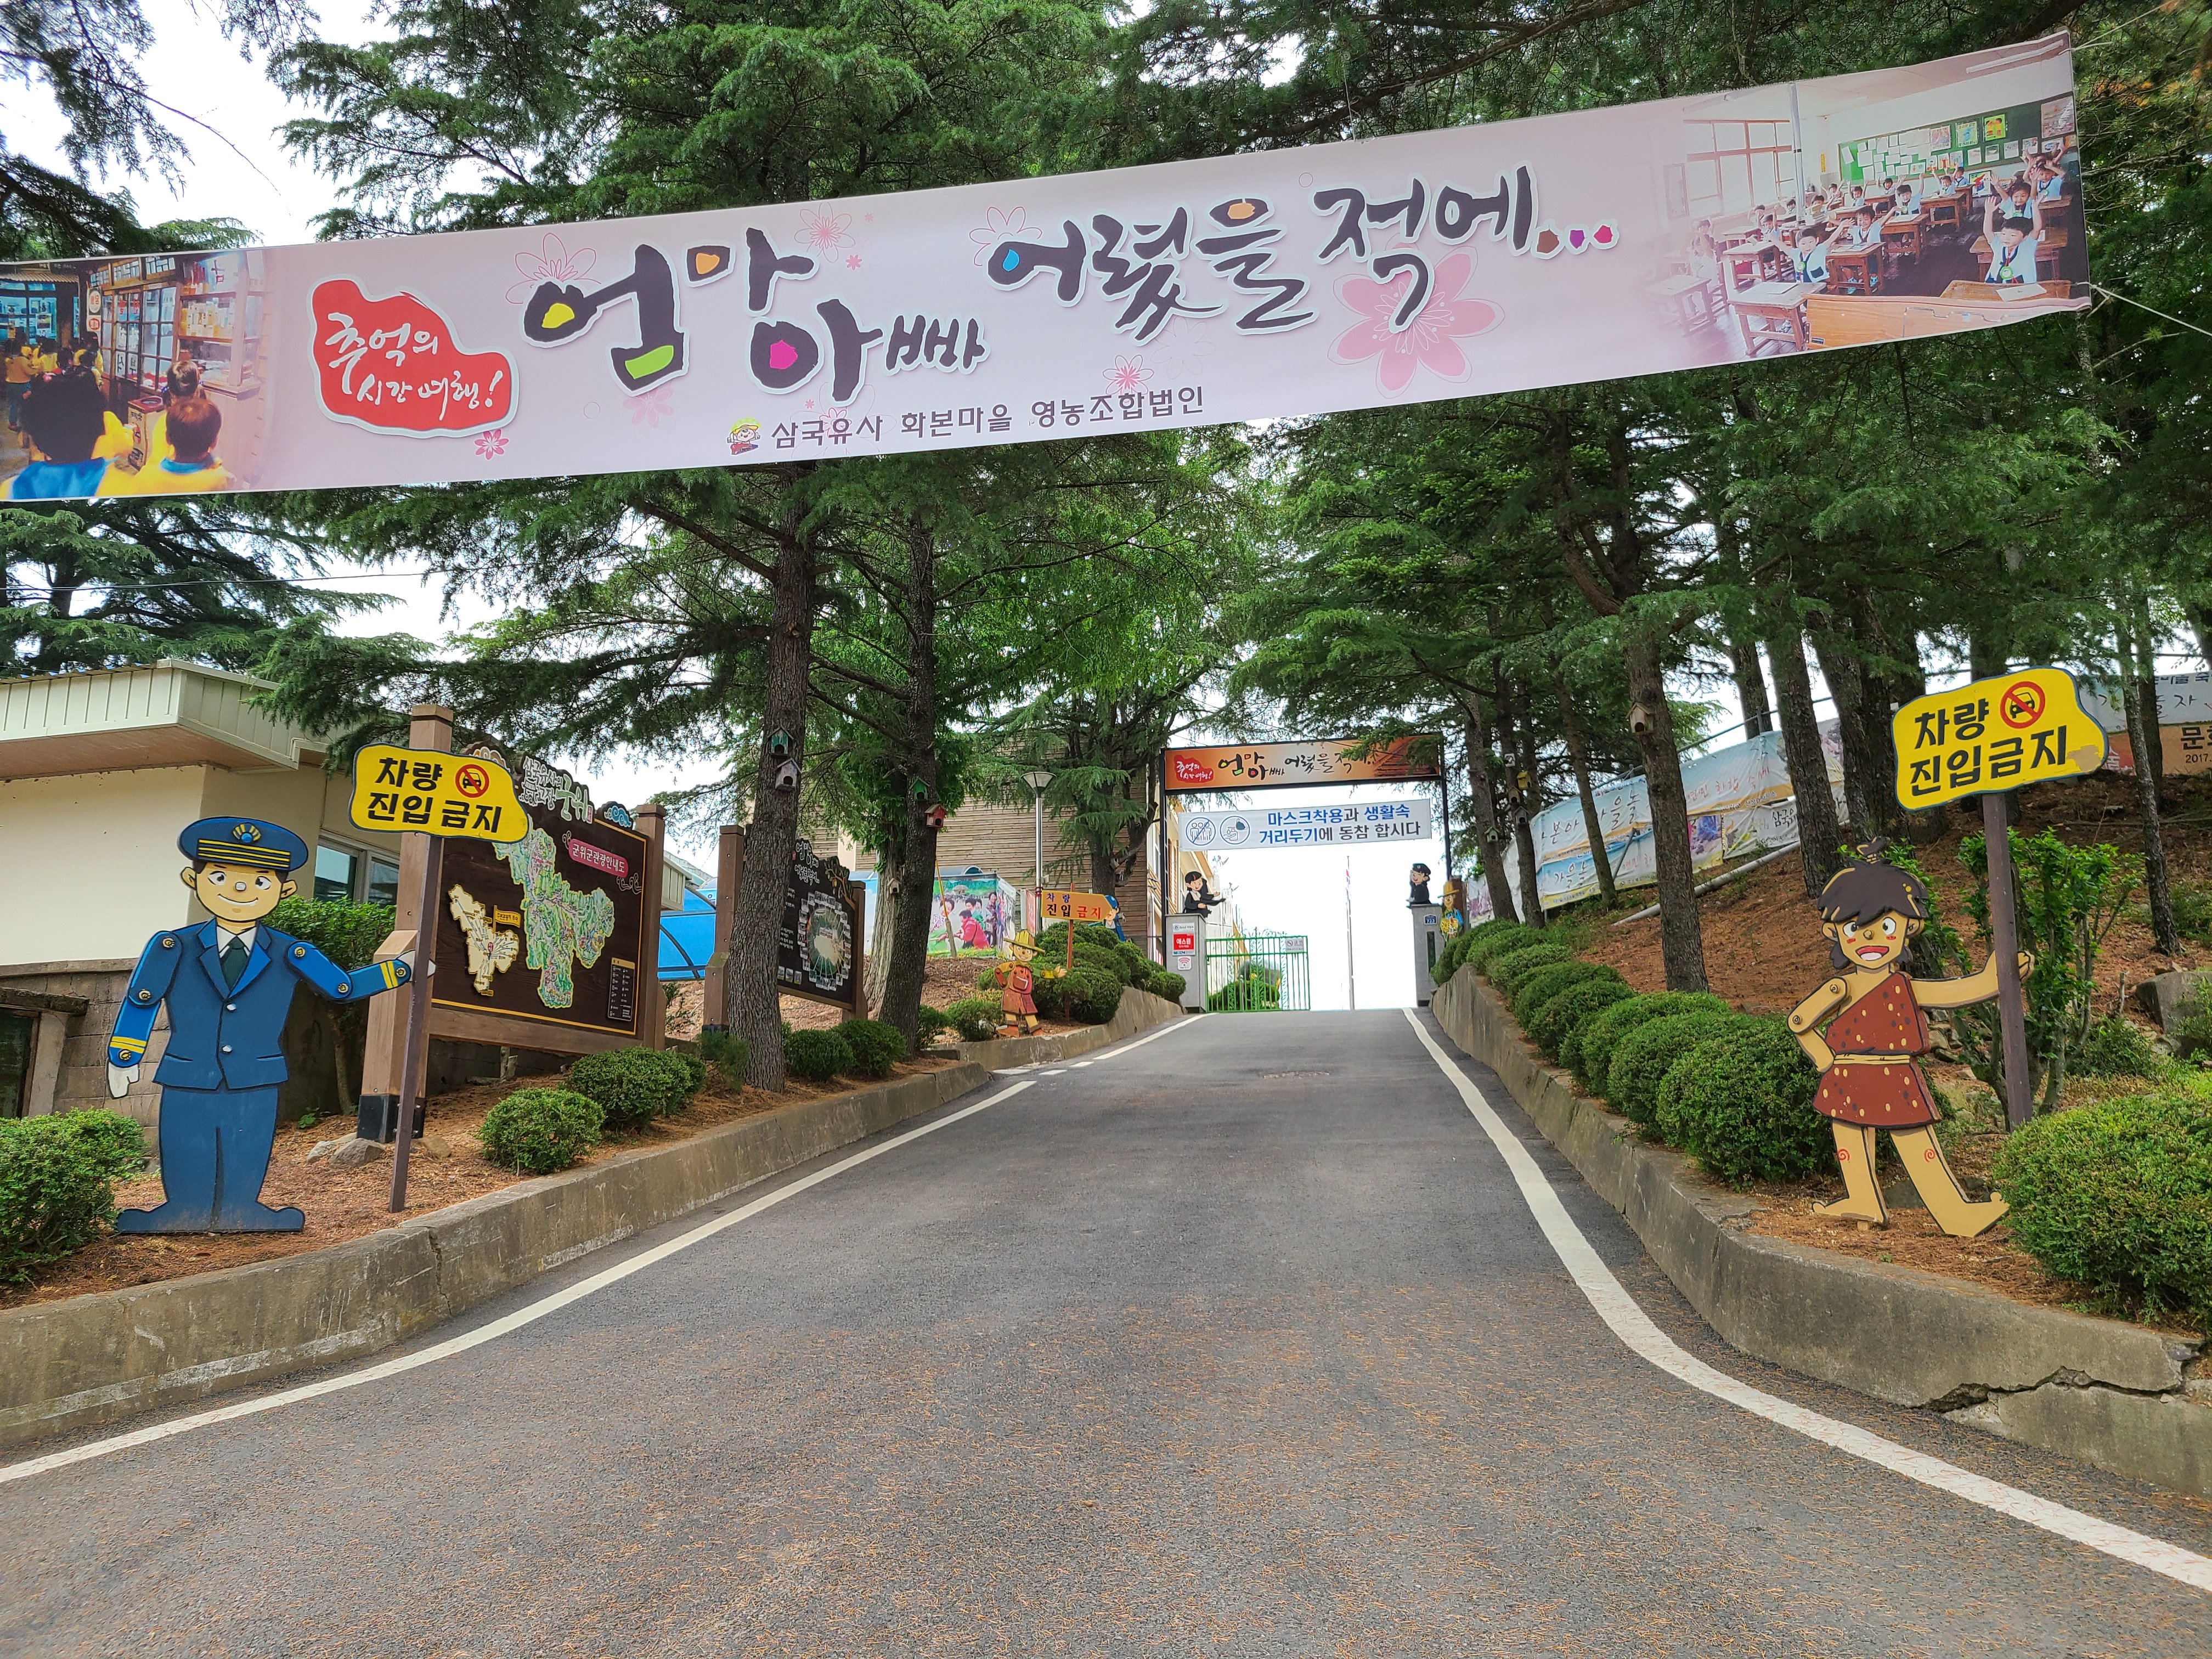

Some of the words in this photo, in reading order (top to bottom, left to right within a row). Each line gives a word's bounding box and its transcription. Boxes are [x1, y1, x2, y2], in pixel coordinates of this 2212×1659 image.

[988, 198, 1315, 342] 어렸을
[523, 227, 817, 390] 엄마
[325, 312, 438, 394] 추억의
[751, 299, 985, 403] 아빠
[357, 374, 413, 405] 시간
[417, 370, 503, 421] 여행!
[771, 415, 882, 448] 삼국유사
[900, 403, 1012, 436] 화본마을
[1031, 386, 1204, 425] 영농조합법인
[1914, 698, 1989, 749] 차량
[375, 757, 443, 791] 차량
[1218, 752, 1265, 776] 엄마
[1248, 765, 1285, 780] 아빠
[1284, 753, 1334, 774] 어렸을
[1260, 827, 1333, 844] 거리두기에
[1339, 825, 1369, 841] 동참
[1374, 821, 1421, 838] 합시다
[1268, 808, 1359, 826] 마스크착용과
[1364, 804, 1410, 821] 생활속
[572, 843, 625, 873] 군위군관광안내도
